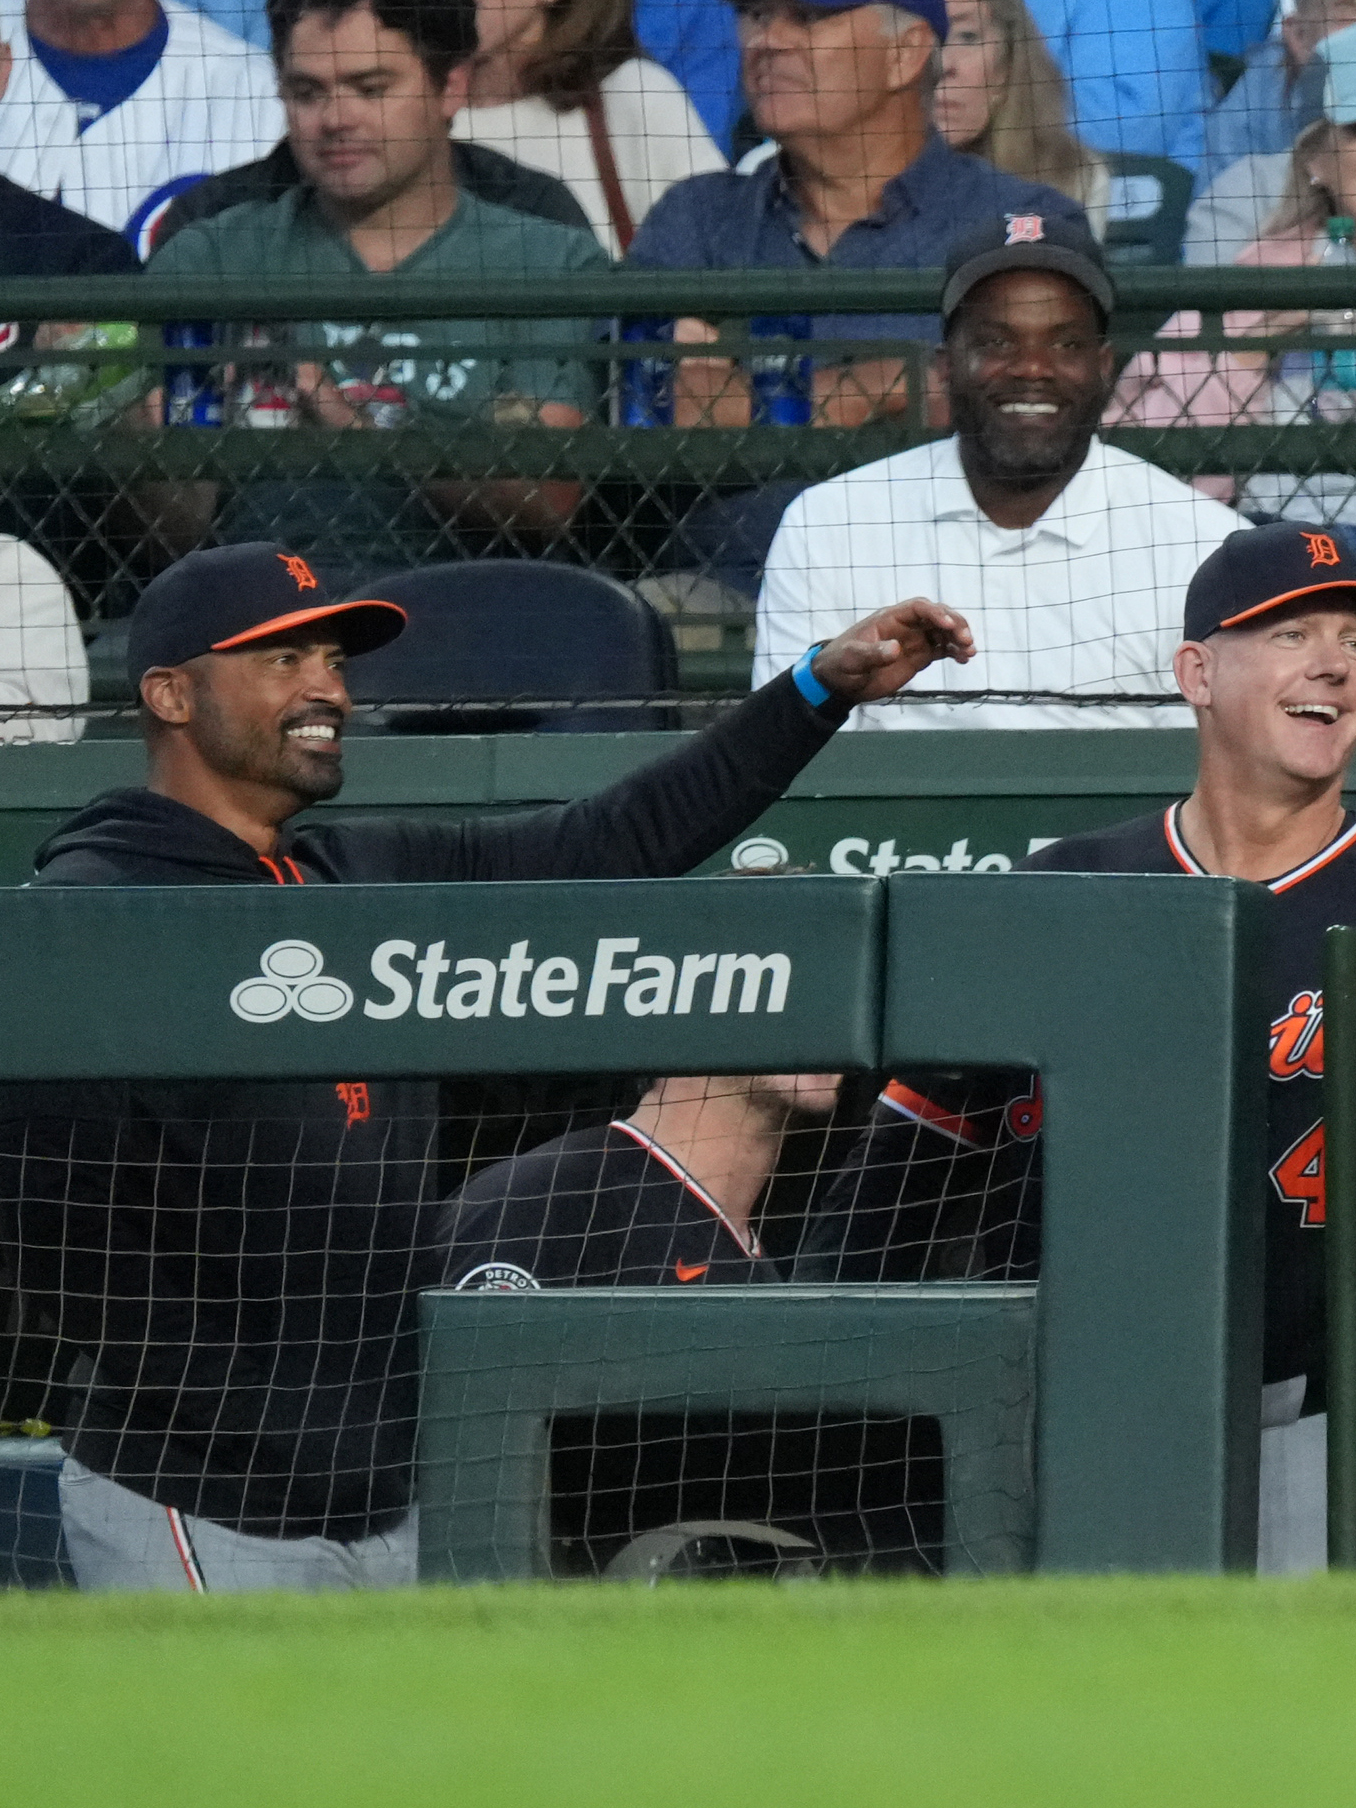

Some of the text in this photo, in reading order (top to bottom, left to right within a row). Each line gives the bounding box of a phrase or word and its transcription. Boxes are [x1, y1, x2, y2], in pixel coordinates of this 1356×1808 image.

[1003, 212, 1046, 246] D
[1299, 531, 1341, 569] D
[275, 553, 318, 592] D
